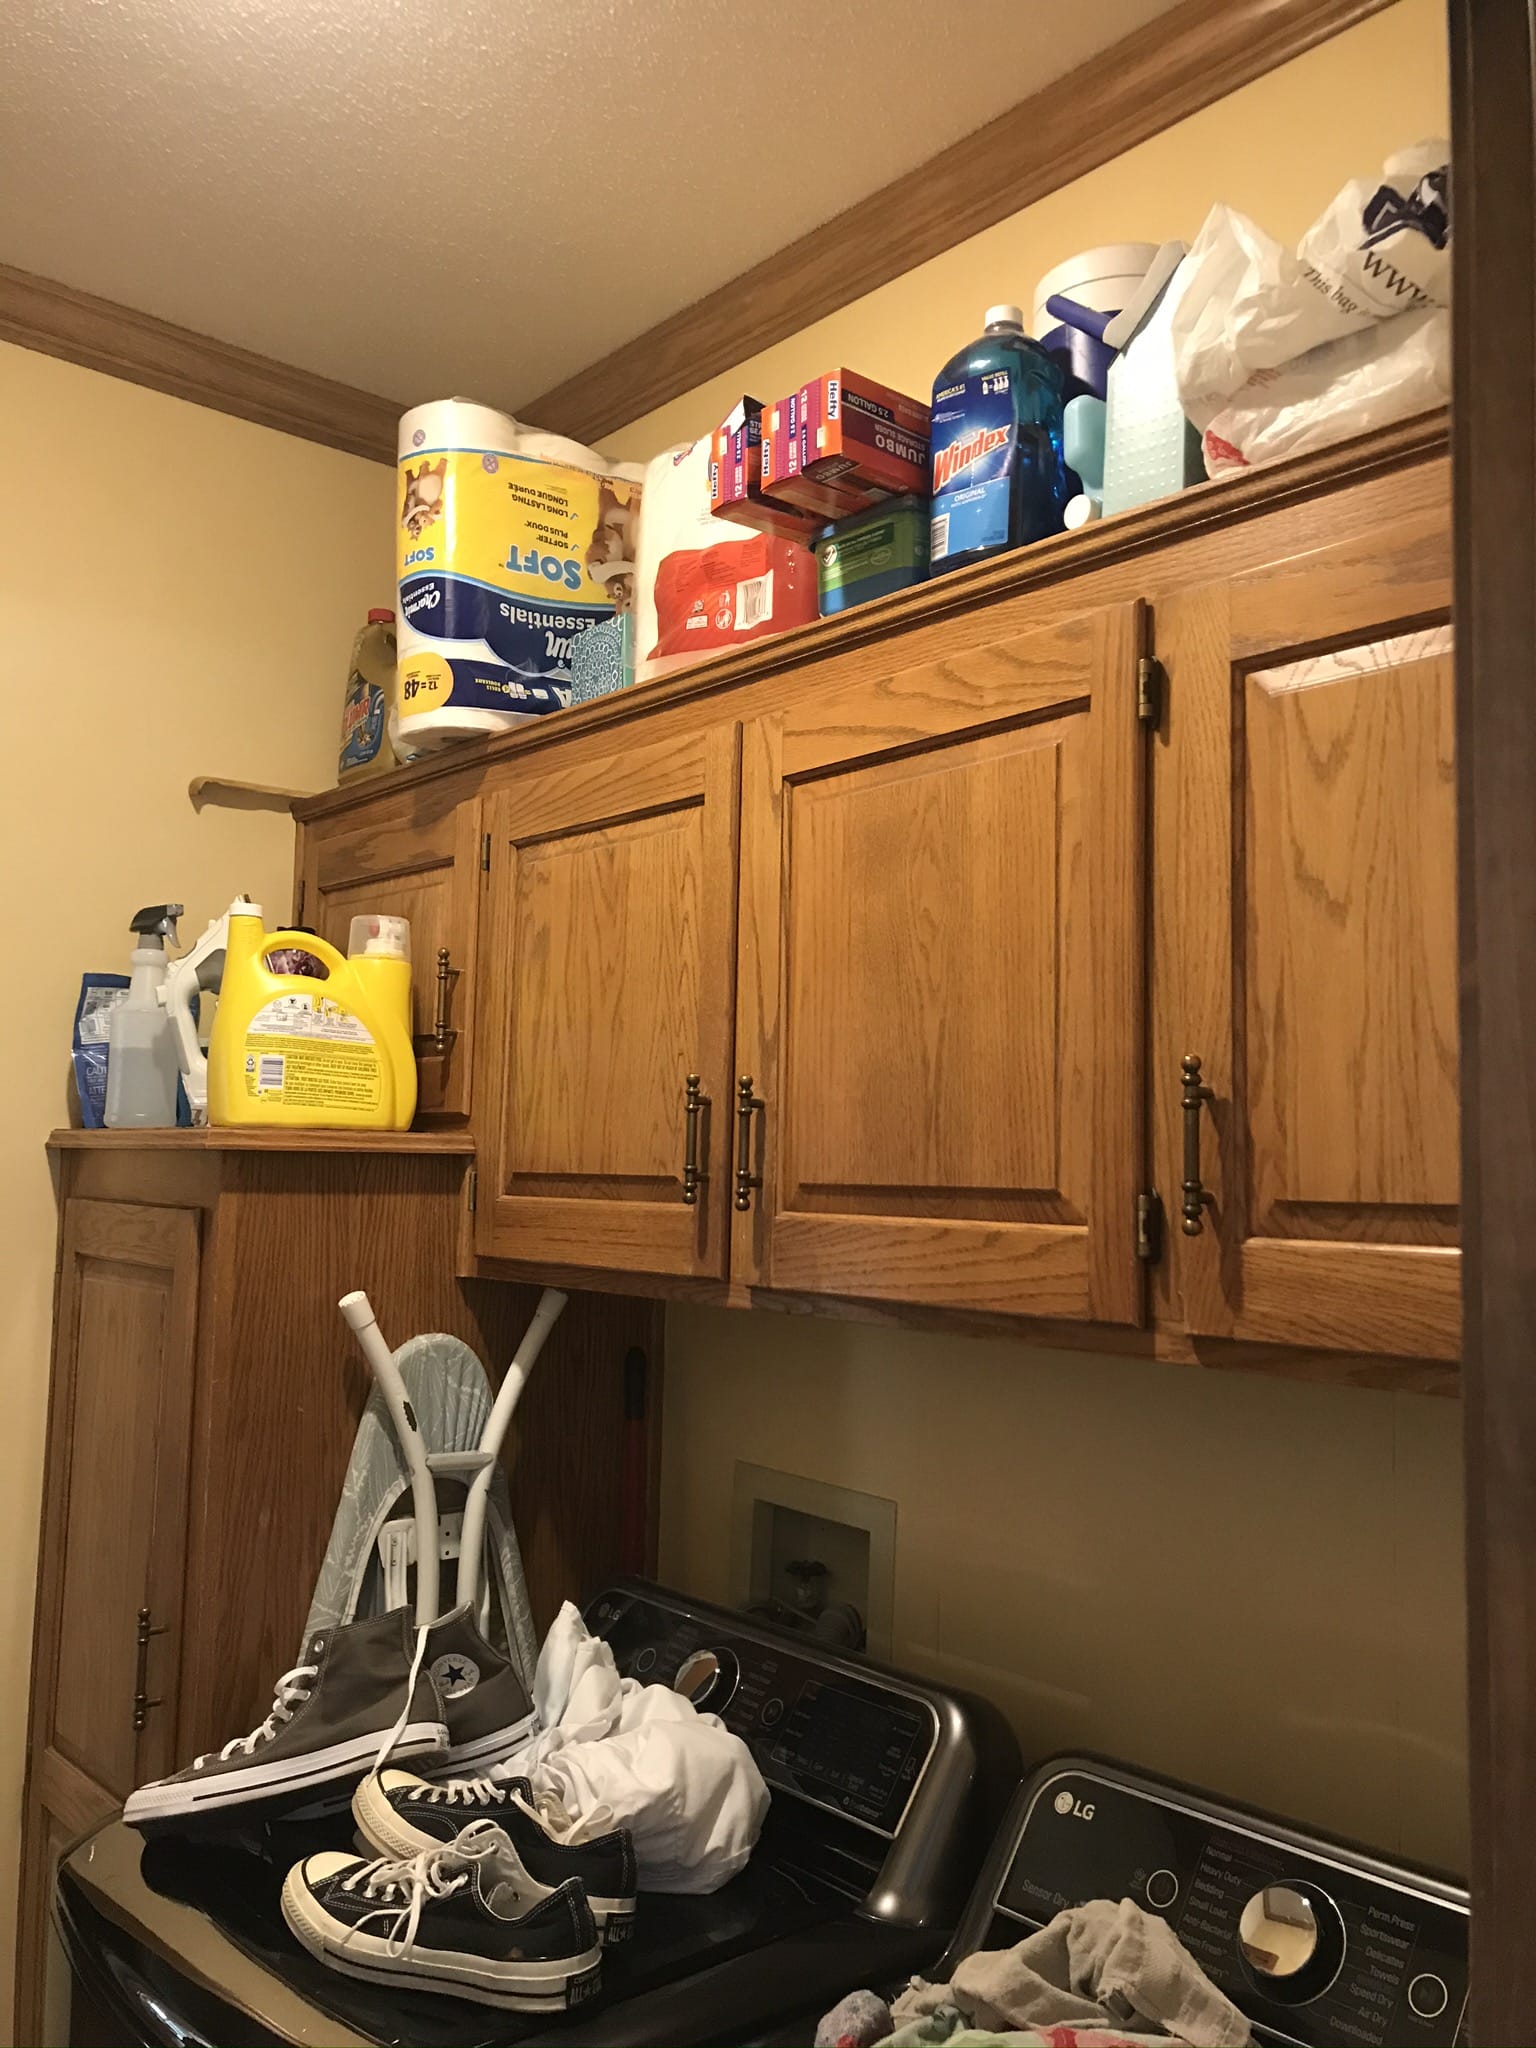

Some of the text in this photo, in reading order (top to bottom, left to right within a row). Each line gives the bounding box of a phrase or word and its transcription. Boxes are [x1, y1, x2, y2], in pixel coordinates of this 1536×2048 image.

[1303, 266, 1358, 314] This bag
[828, 382, 839, 418] Hefty
[848, 393, 877, 414] GALLON
[762, 441, 771, 474] Hefty
[875, 434, 926, 464] JUMBO
[933, 424, 1011, 496] Windex
[507, 482, 536, 496] DURÉE
[711, 464, 719, 498] Hefty
[511, 493, 569, 518] LONG LASTING
[536, 490, 569, 507] LONGUE
[954, 487, 986, 502] ORIGINAL
[550, 527, 569, 539] PLUS
[404, 547, 434, 566] SOFT
[506, 545, 582, 590] SOFT
[1073, 1799, 1096, 1821] LG
[1200, 1863, 1241, 1886] Heavy Duty
[1022, 1879, 1070, 1909] Sensor Dry
[1368, 1905, 1416, 1932] Perm Press
[1370, 1965, 1400, 1985] Towels
[1358, 2006, 1388, 2027] Air Dry
